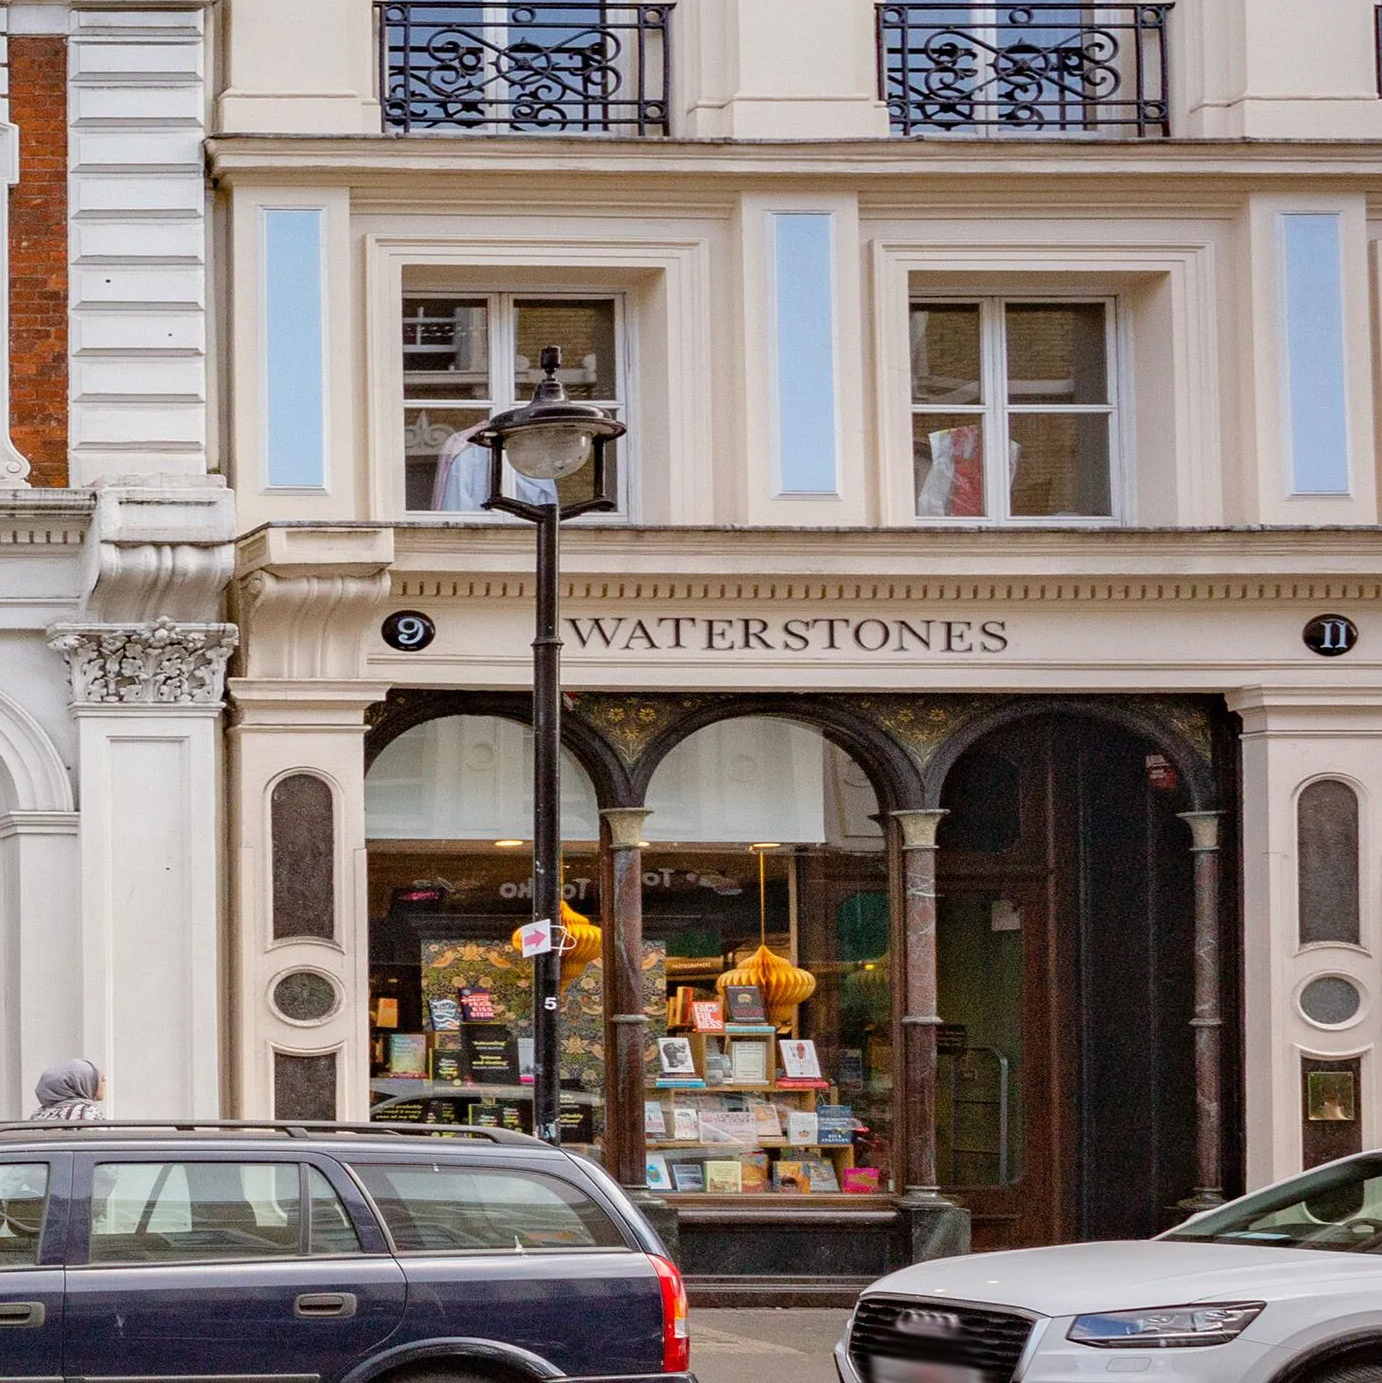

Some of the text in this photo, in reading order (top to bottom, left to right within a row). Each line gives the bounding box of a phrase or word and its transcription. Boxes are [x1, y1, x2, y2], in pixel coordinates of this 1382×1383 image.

[398, 617, 424, 645] 9
[565, 617, 1009, 654] WATERSTONES
[1320, 621, 1348, 649] 11
[544, 996, 557, 1011] 5
